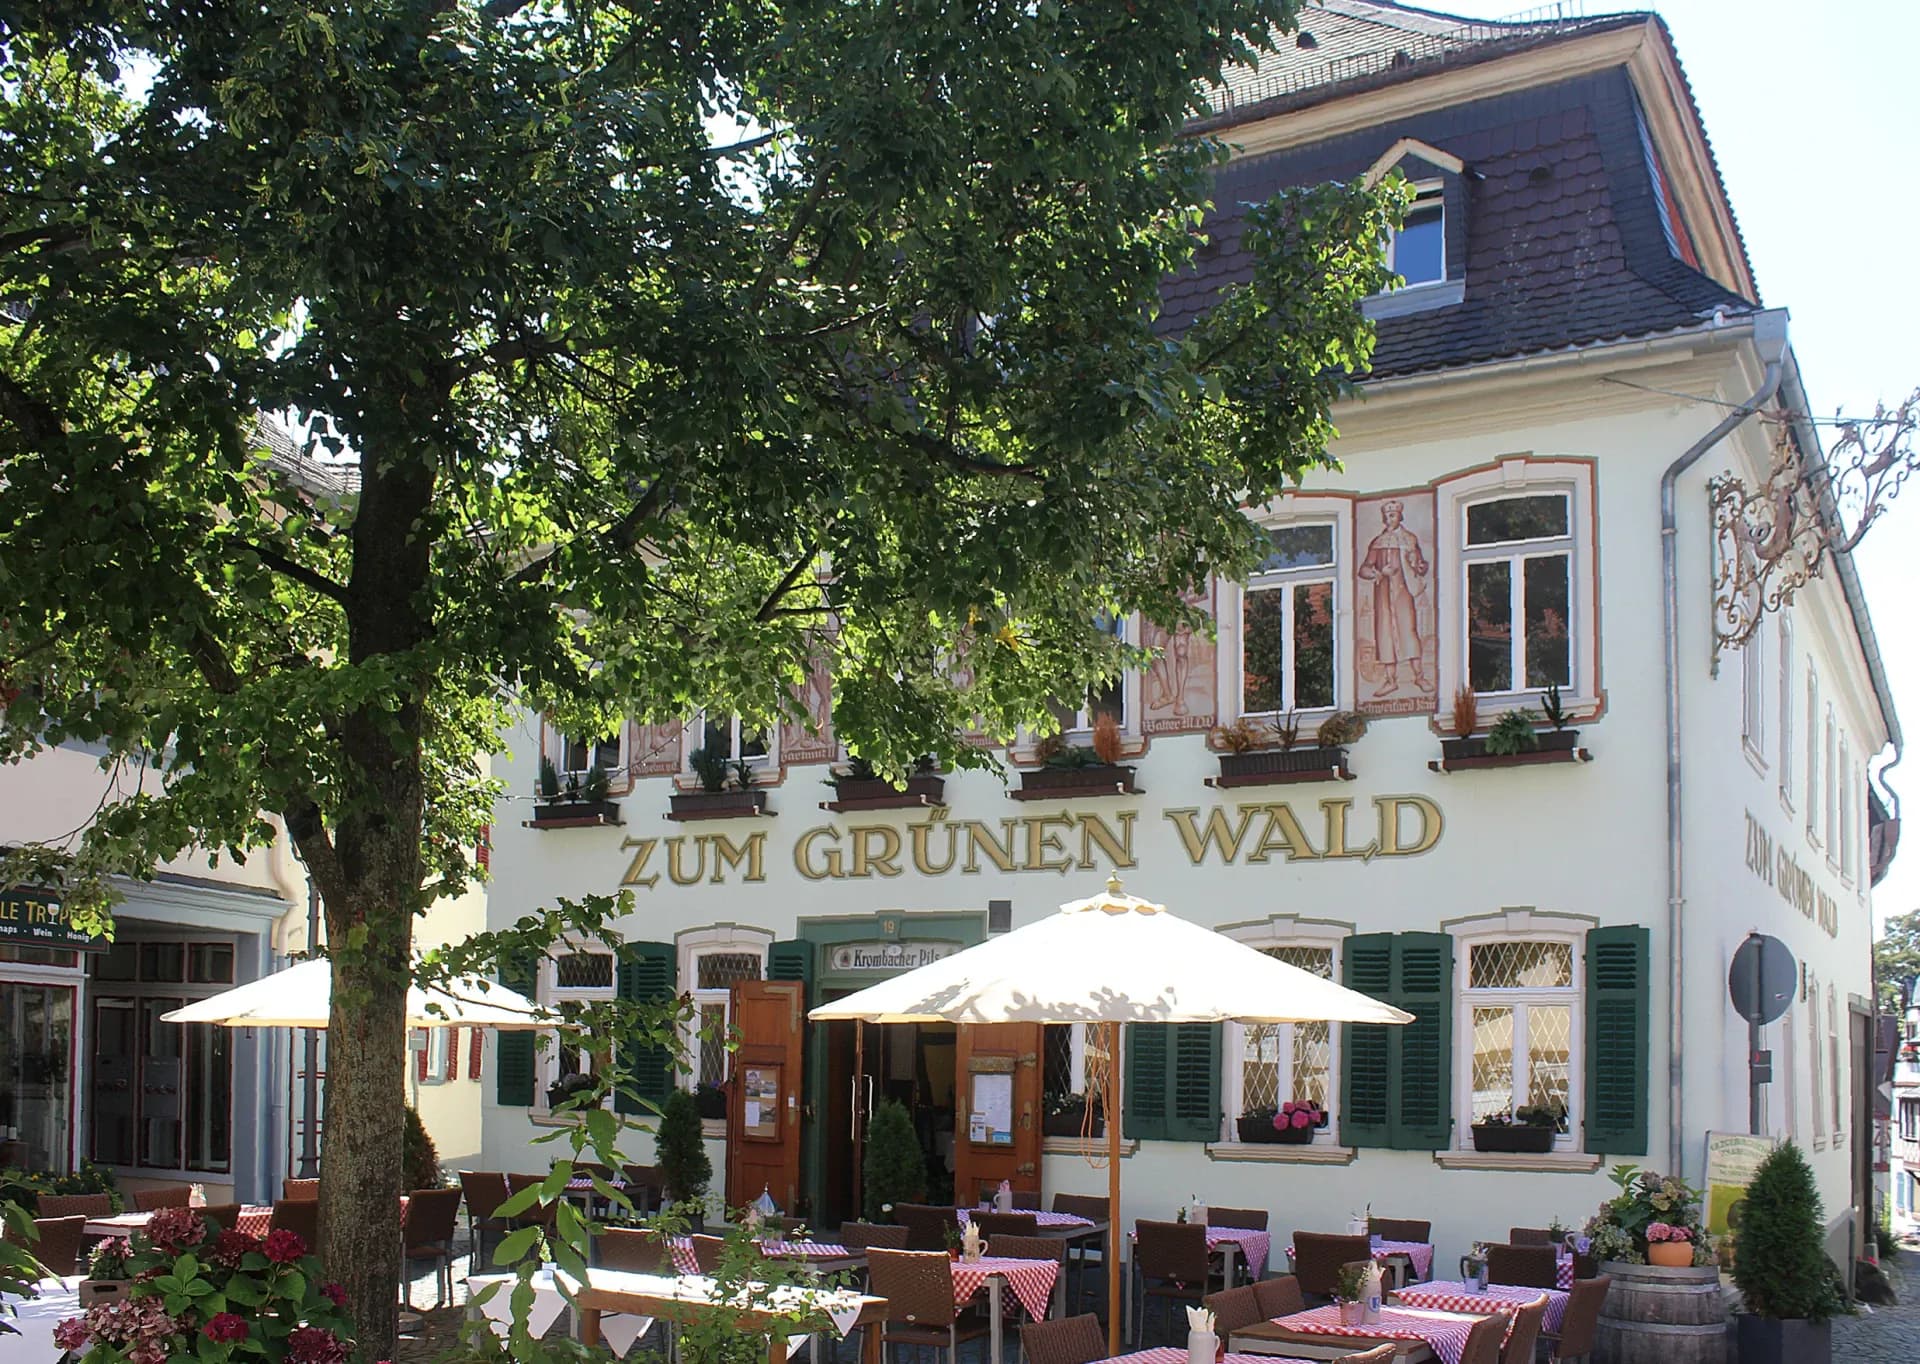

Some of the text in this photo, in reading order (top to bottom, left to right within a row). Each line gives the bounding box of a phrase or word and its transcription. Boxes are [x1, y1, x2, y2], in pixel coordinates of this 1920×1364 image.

[619, 793, 1446, 890] ZUM GRÜNEN WALD
[1745, 807, 1773, 887] ZUM
[1817, 884, 1838, 939] WALD
[33, 927, 53, 937] Wein
[66, 931, 90, 943] Honig
[854, 947, 941, 968] Krombacher Pils
